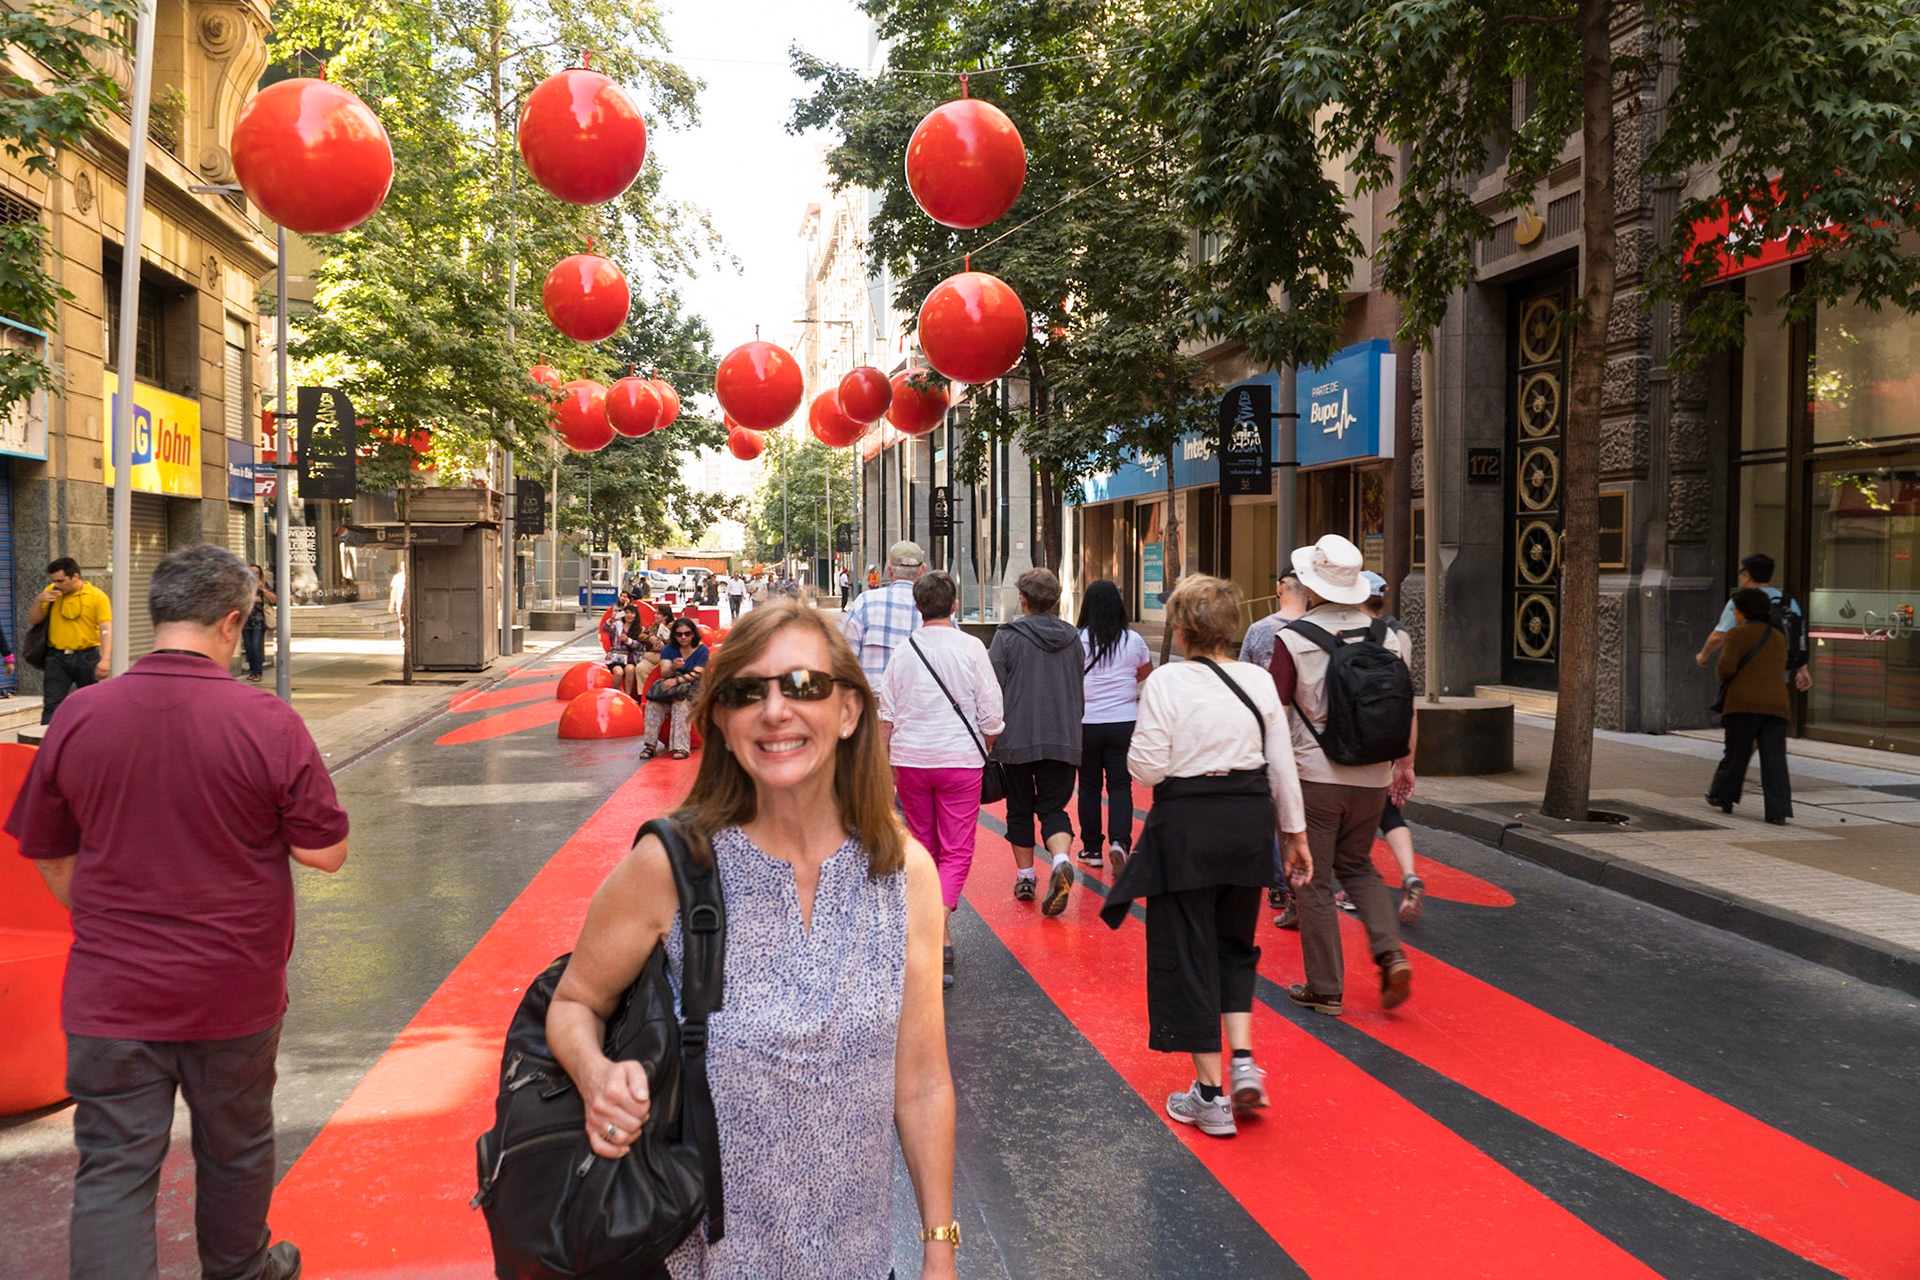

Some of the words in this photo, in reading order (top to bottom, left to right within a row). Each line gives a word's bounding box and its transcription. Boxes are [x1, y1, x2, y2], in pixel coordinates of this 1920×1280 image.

[1312, 383, 1330, 397] PARTE
[1330, 381, 1339, 393] DE
[1311, 402, 1339, 426] Bupa
[131, 412, 149, 456] IG
[155, 418, 191, 467] John
[1470, 455, 1500, 476] 172
